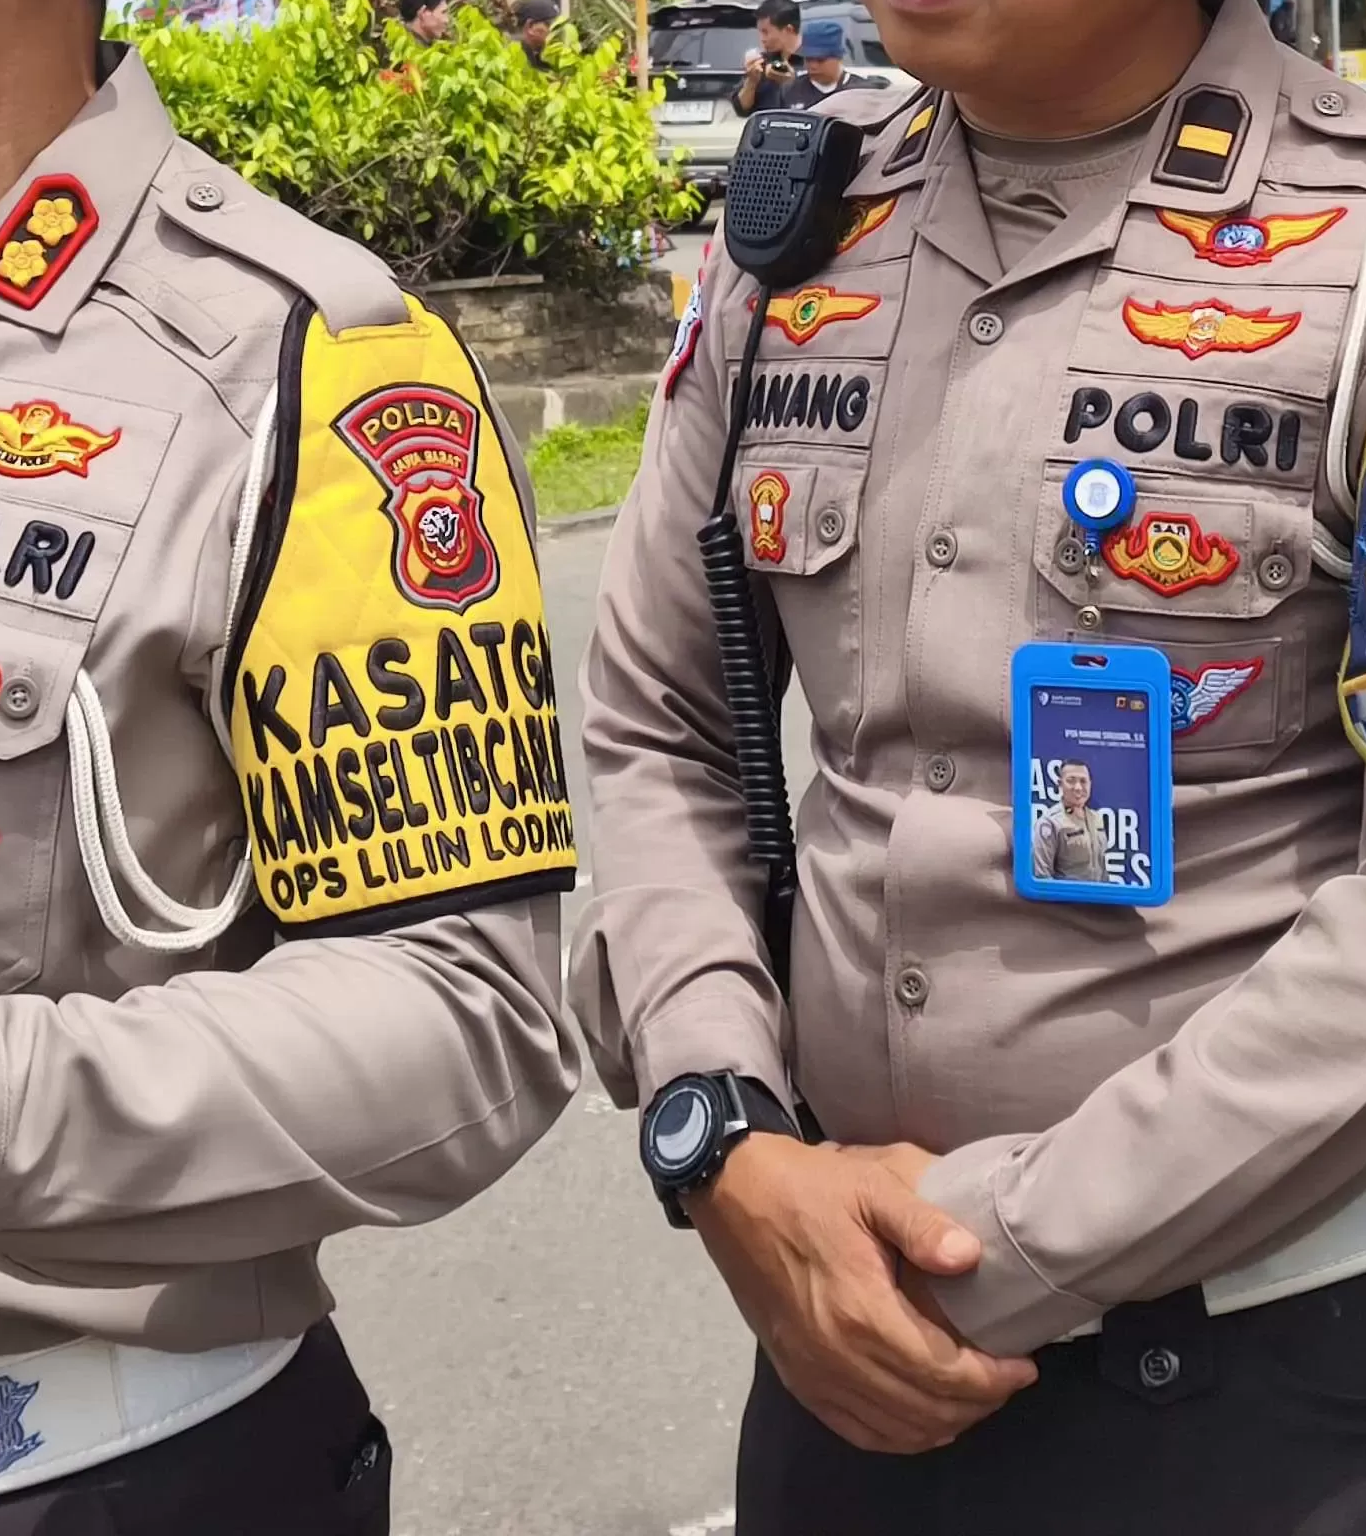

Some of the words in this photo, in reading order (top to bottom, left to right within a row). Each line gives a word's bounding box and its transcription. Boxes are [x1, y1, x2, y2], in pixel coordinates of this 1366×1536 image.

[360, 402, 464, 446] POLDA
[732, 373, 871, 433] ANANG
[1063, 387, 1301, 472] POLRI
[271, 856, 348, 910] OPS
[358, 826, 471, 889] LILIN
